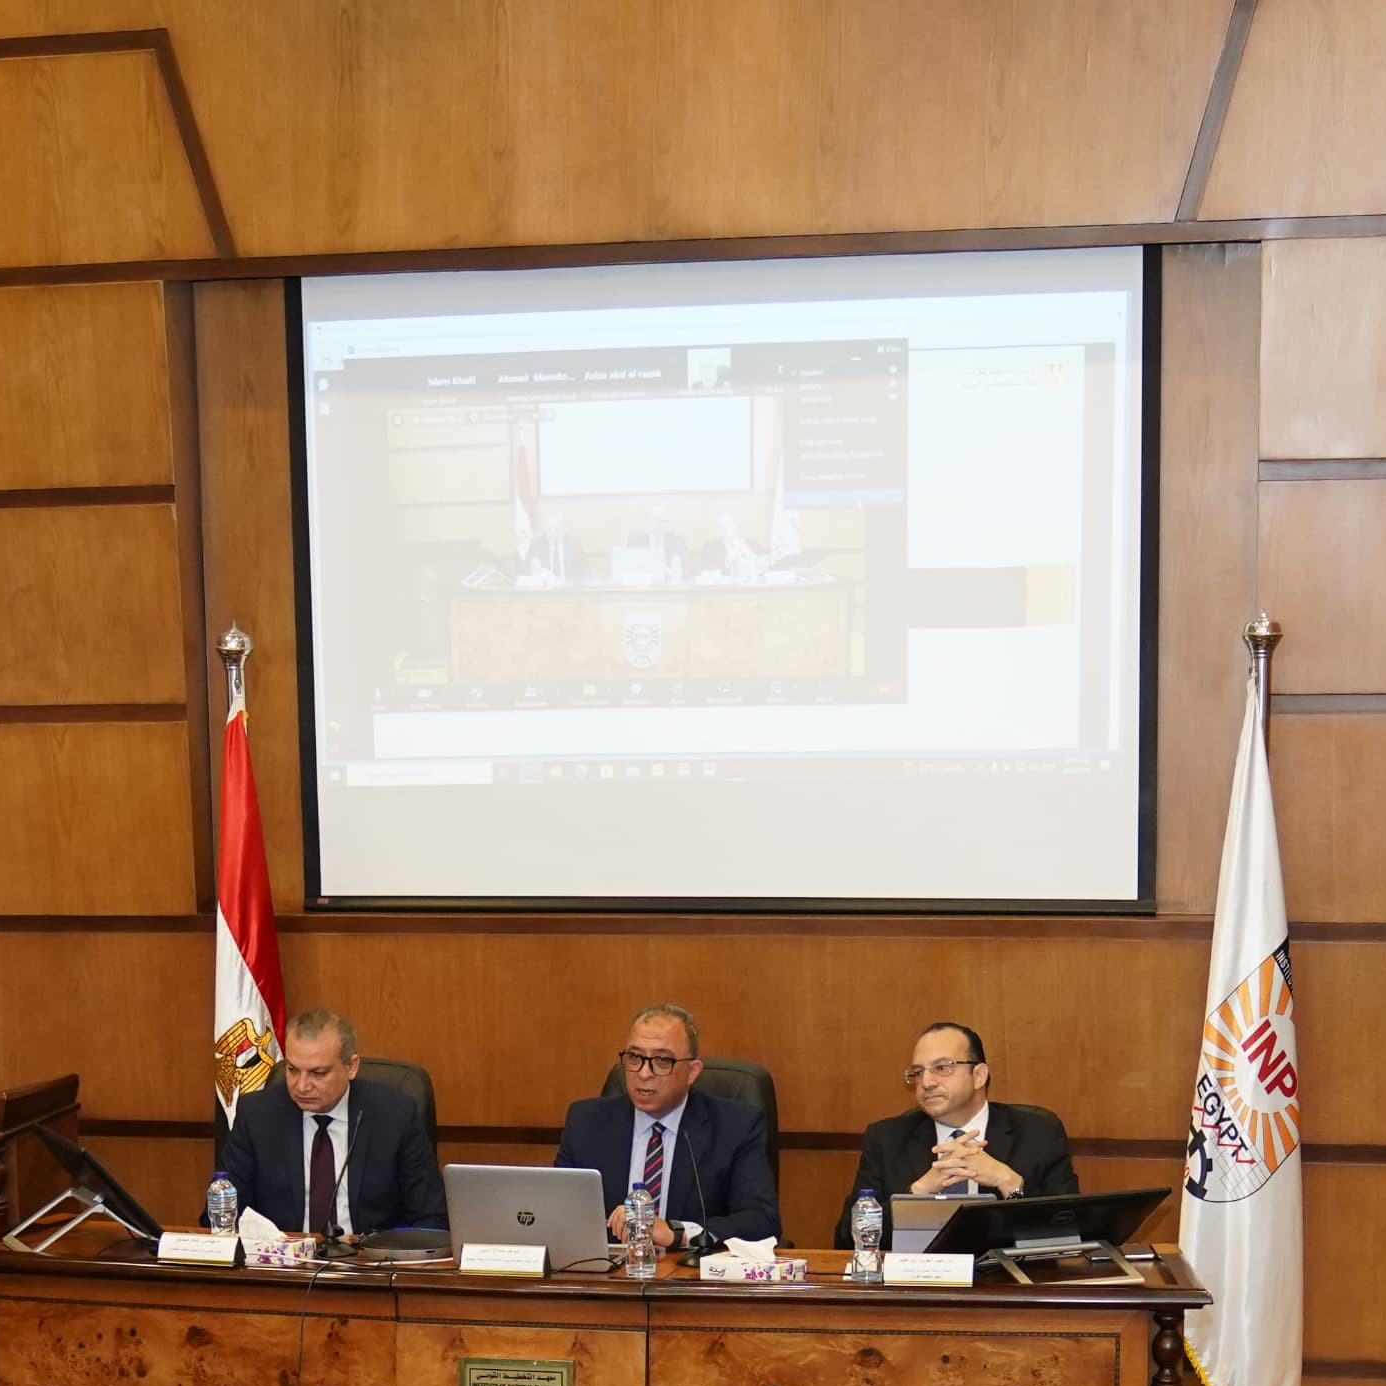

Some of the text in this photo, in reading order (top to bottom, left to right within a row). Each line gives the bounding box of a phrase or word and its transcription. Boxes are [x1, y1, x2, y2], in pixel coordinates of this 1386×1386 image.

[1241, 1018, 1298, 1098] INP
[1196, 1073, 1249, 1159] EGYPT
[516, 1211, 535, 1226] hp
